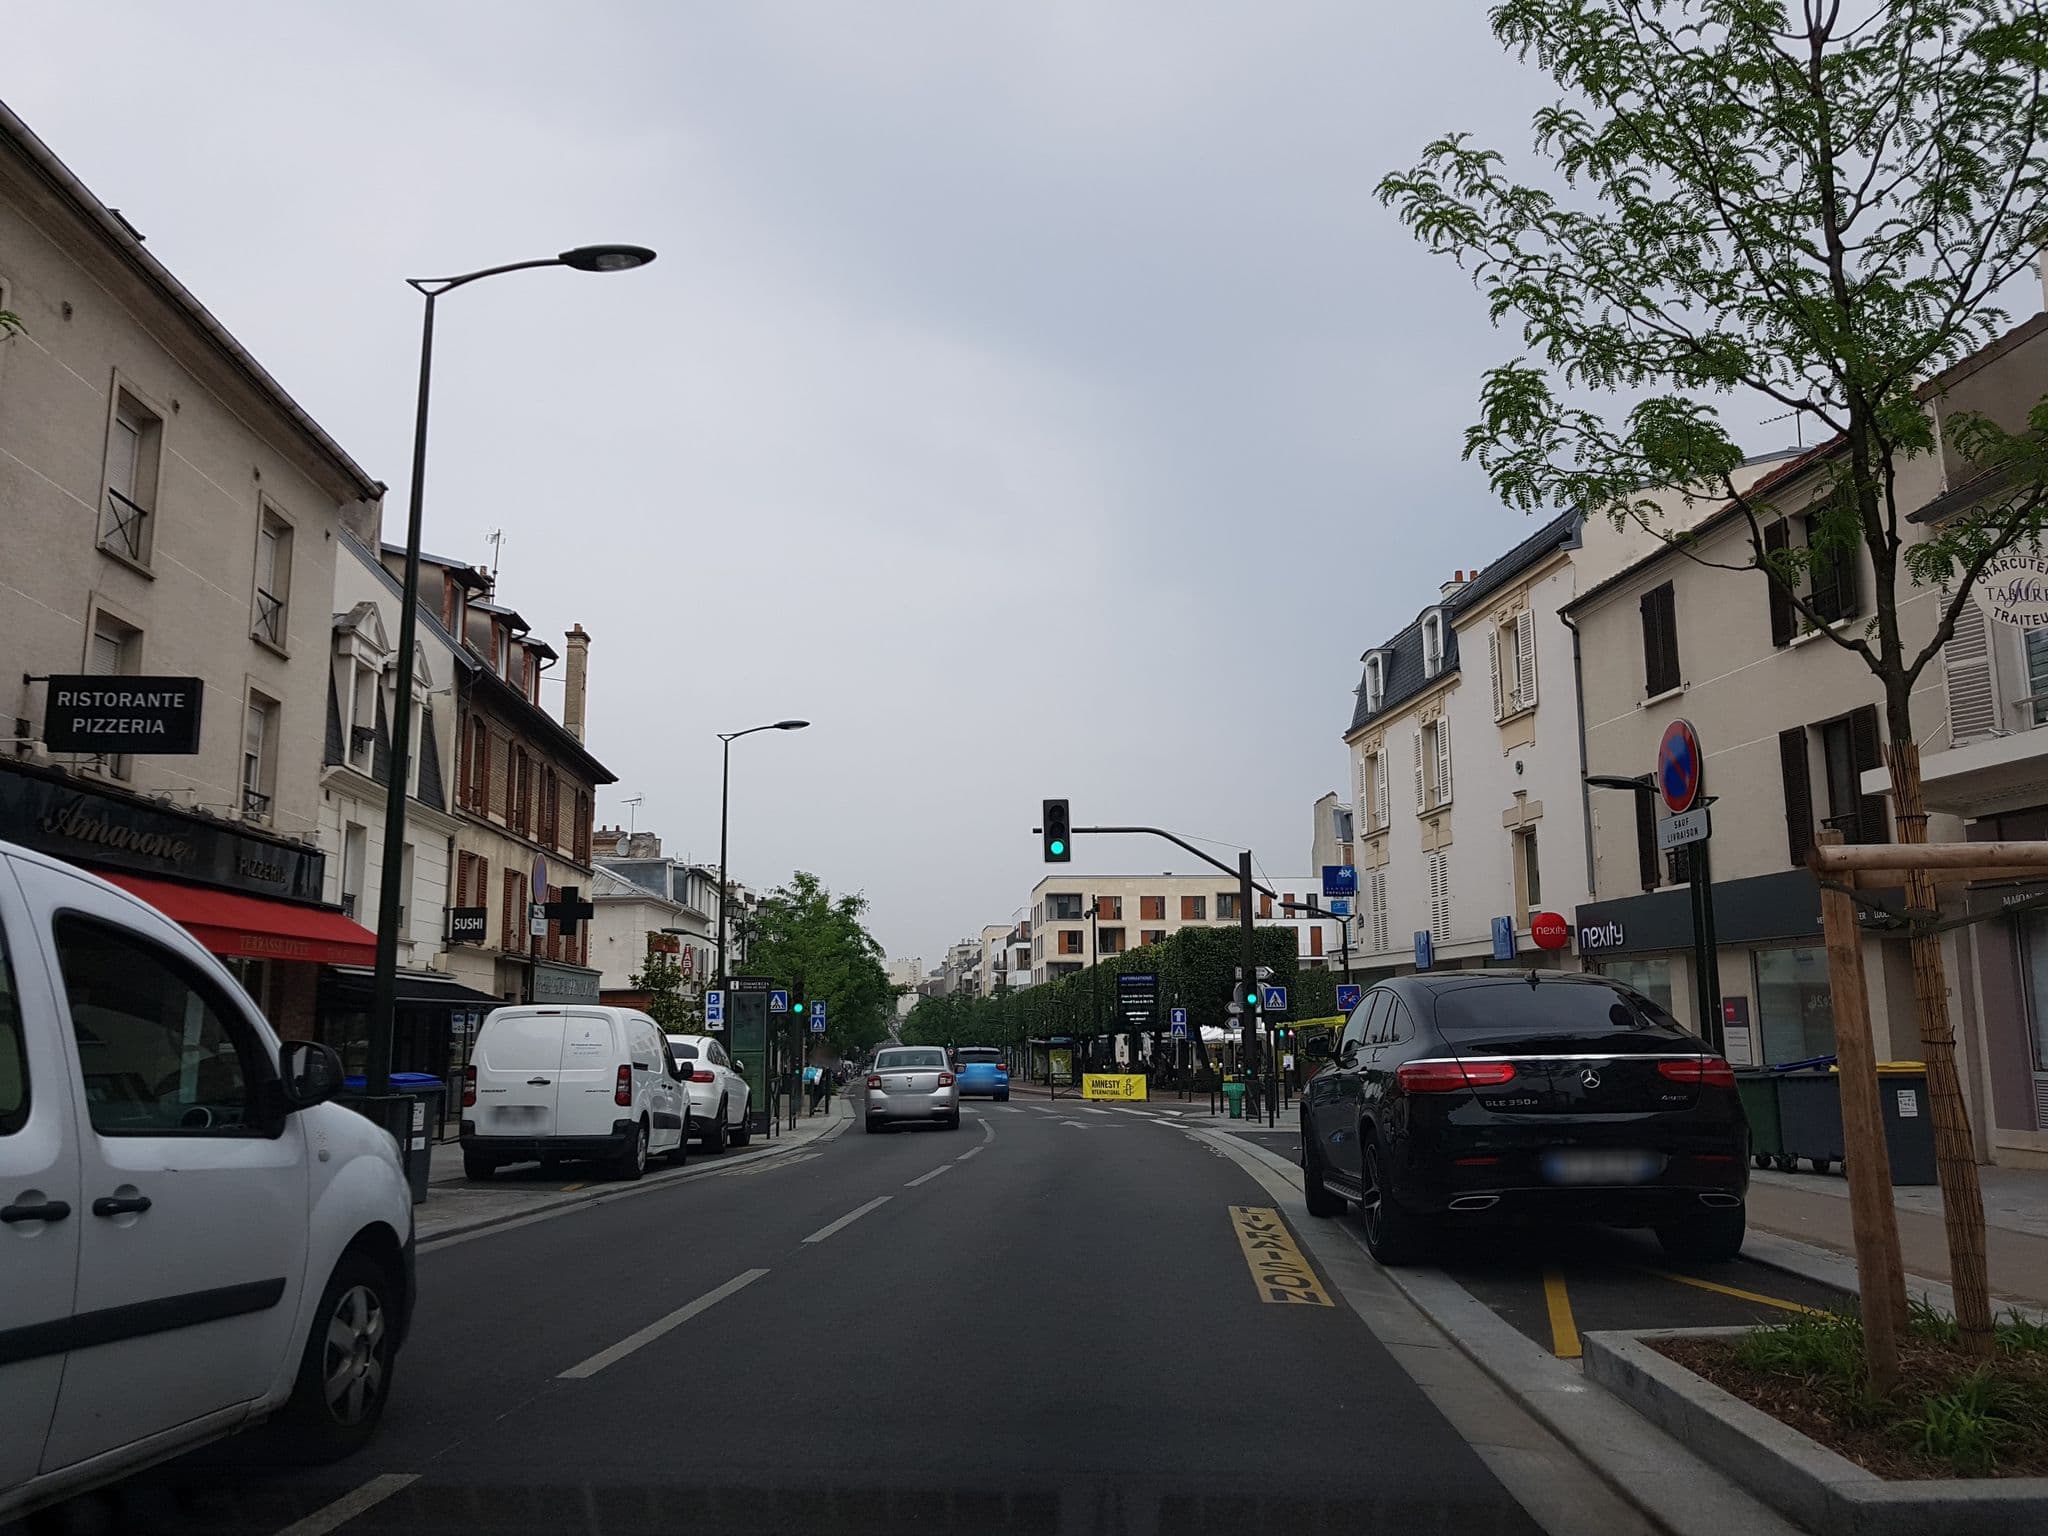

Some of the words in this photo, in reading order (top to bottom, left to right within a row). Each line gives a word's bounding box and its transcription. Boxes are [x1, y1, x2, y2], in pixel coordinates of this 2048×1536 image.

[1976, 558, 2048, 585] CHARCUTE
[57, 691, 185, 708] RISTORANTE
[72, 718, 165, 734] PIZZERIA
[1674, 817, 1689, 829] SAUF
[1667, 827, 1698, 843] LIVRAISON
[454, 918, 484, 930] SUSHI
[1536, 926, 1567, 935] nexity
[1581, 922, 1624, 949] nexity
[682, 945, 693, 976] TABA
[1091, 1080, 1120, 1089] AMNESTY
